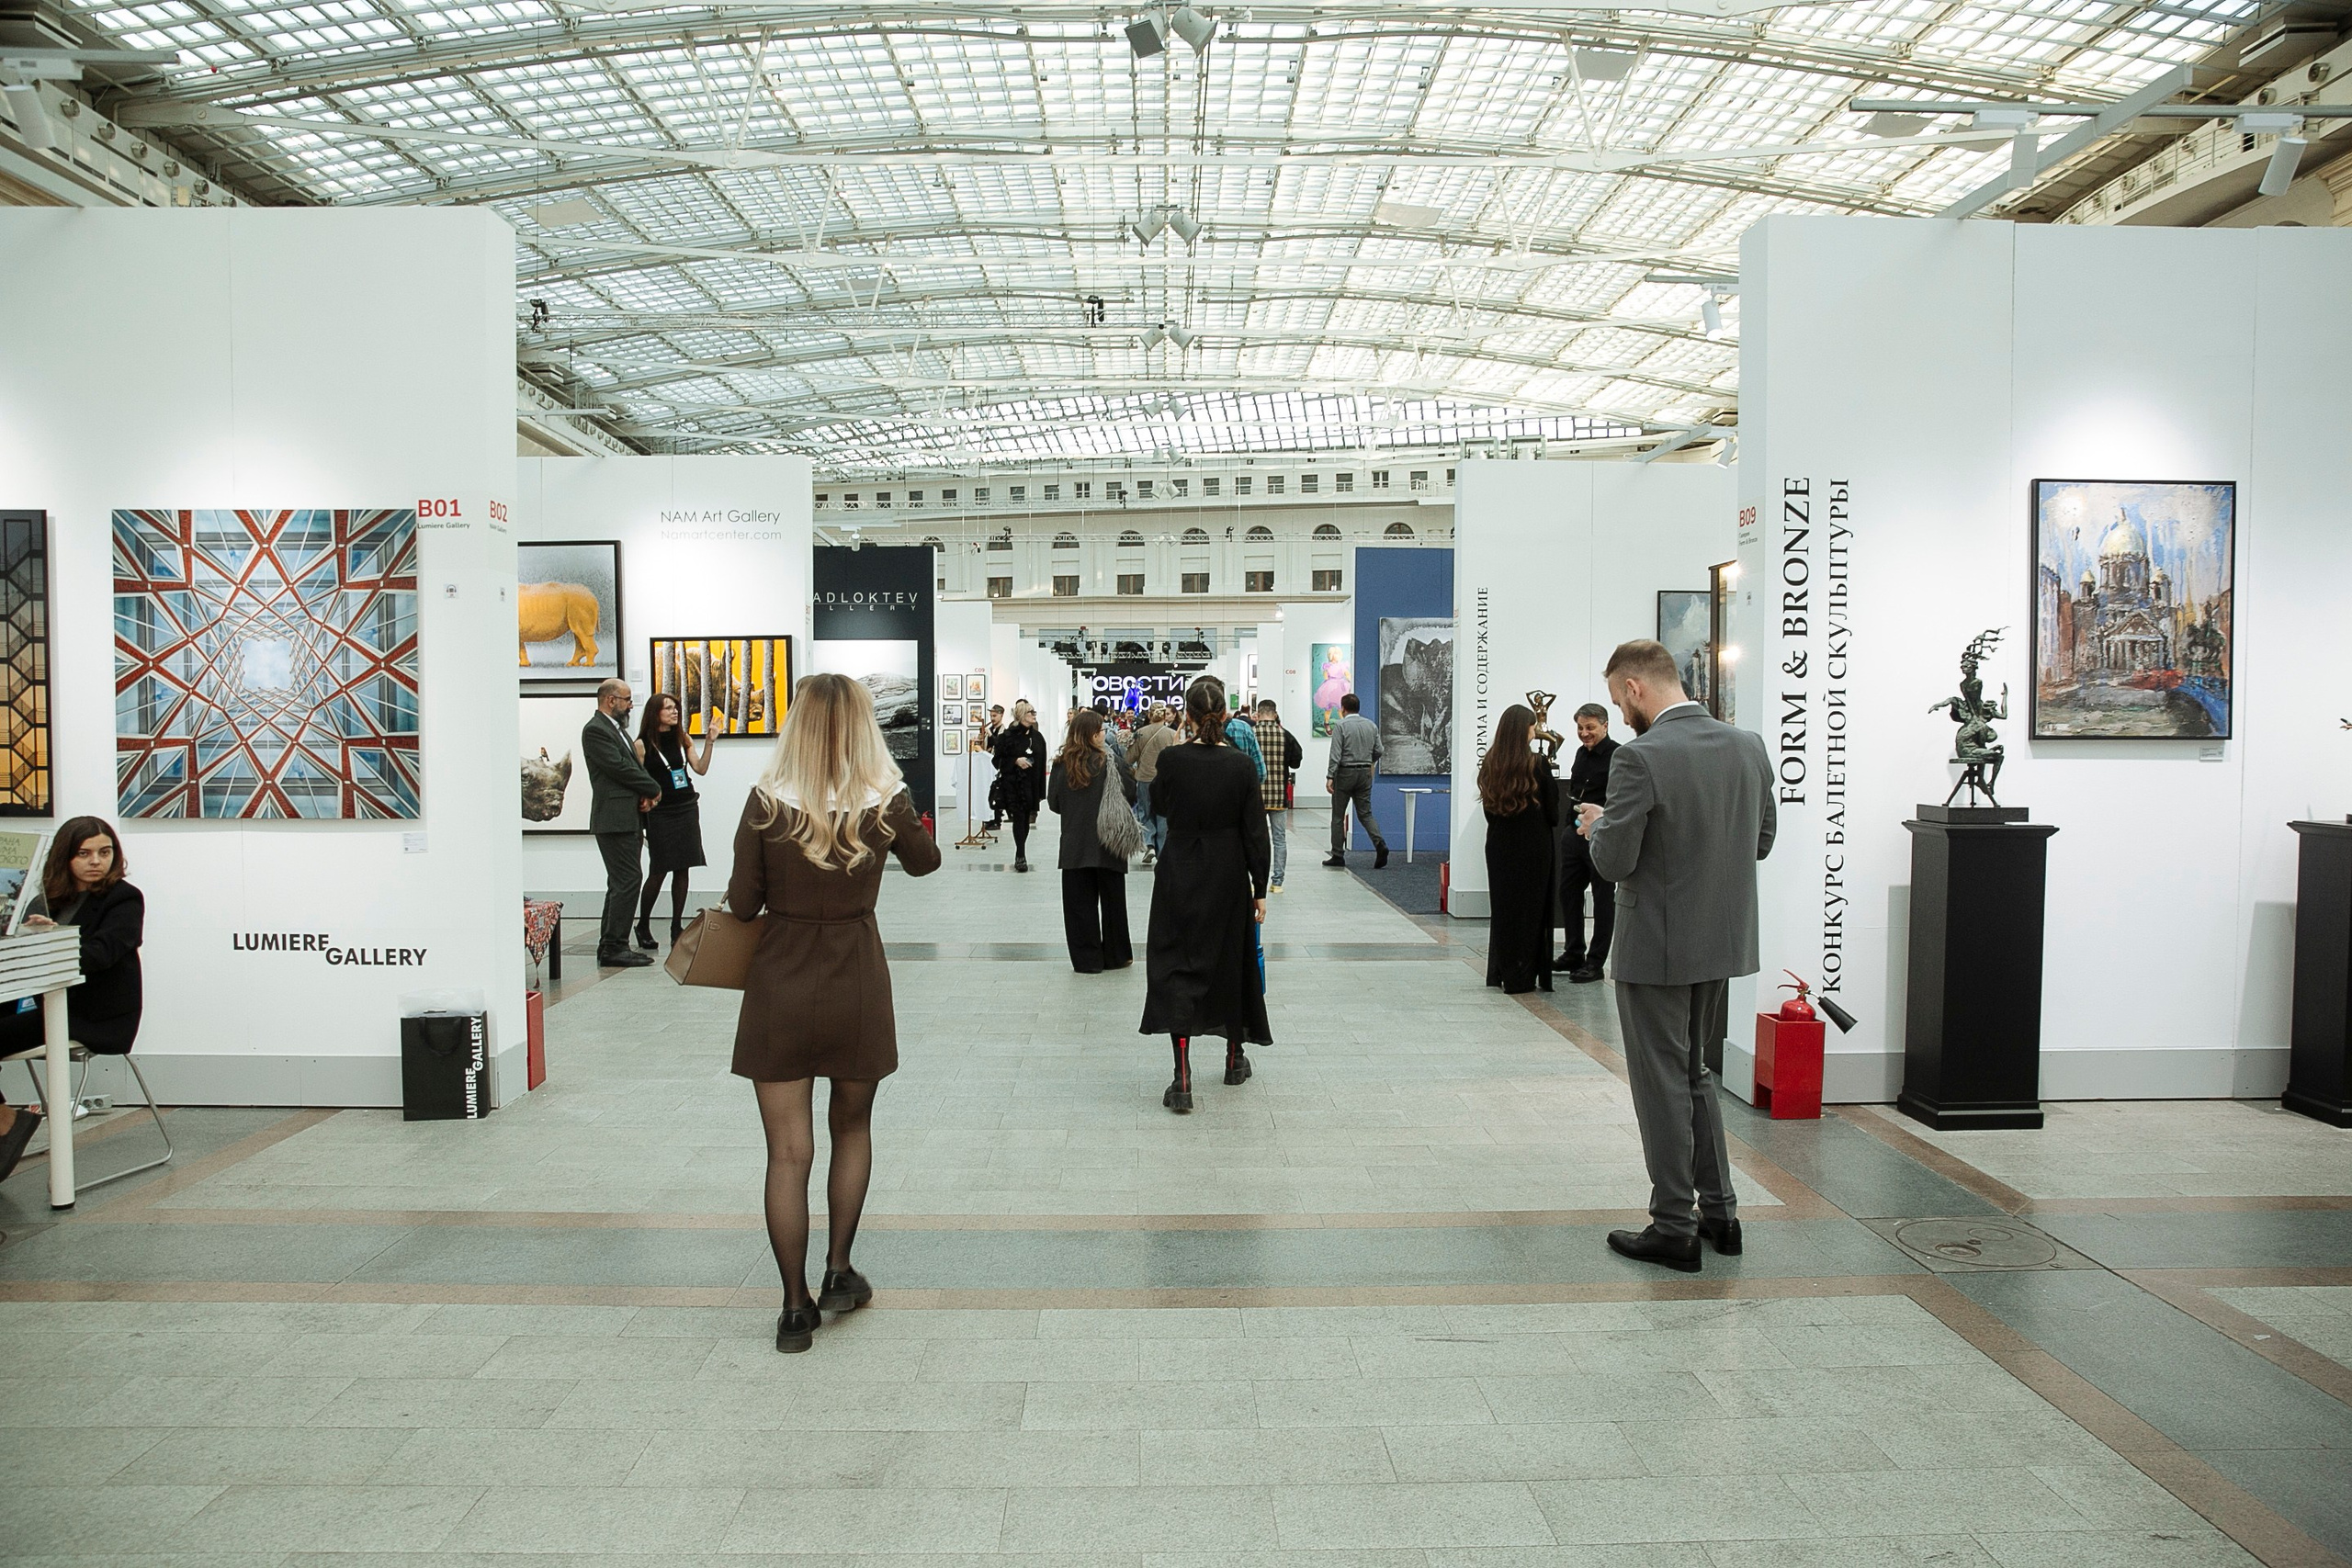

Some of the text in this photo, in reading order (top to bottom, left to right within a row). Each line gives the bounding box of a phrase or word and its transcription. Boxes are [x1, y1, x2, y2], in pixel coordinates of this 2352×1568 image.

[418, 499, 462, 517] B01
[490, 500, 507, 523] B02
[1739, 506, 1756, 527] B09
[446, 522, 470, 530] Gallery
[661, 510, 781, 525] NAM Art Gallery
[661, 530, 782, 540] Namartcenter.com
[1477, 587, 1489, 694] СОДЕРЖАНИЕ
[1781, 477, 1810, 806] FORM & BRONZE
[1091, 675, 1184, 691] овости
[1477, 699, 1487, 710] И
[1822, 479, 1854, 994] КОНКУРС БАЛЕТНОЙ СКУЛЬПТУРЫ
[233, 933, 330, 951] LUMIERE
[325, 947, 427, 965] GALLERY
[470, 1017, 483, 1071] GALLERY
[465, 1067, 478, 1119] LUMIERE
